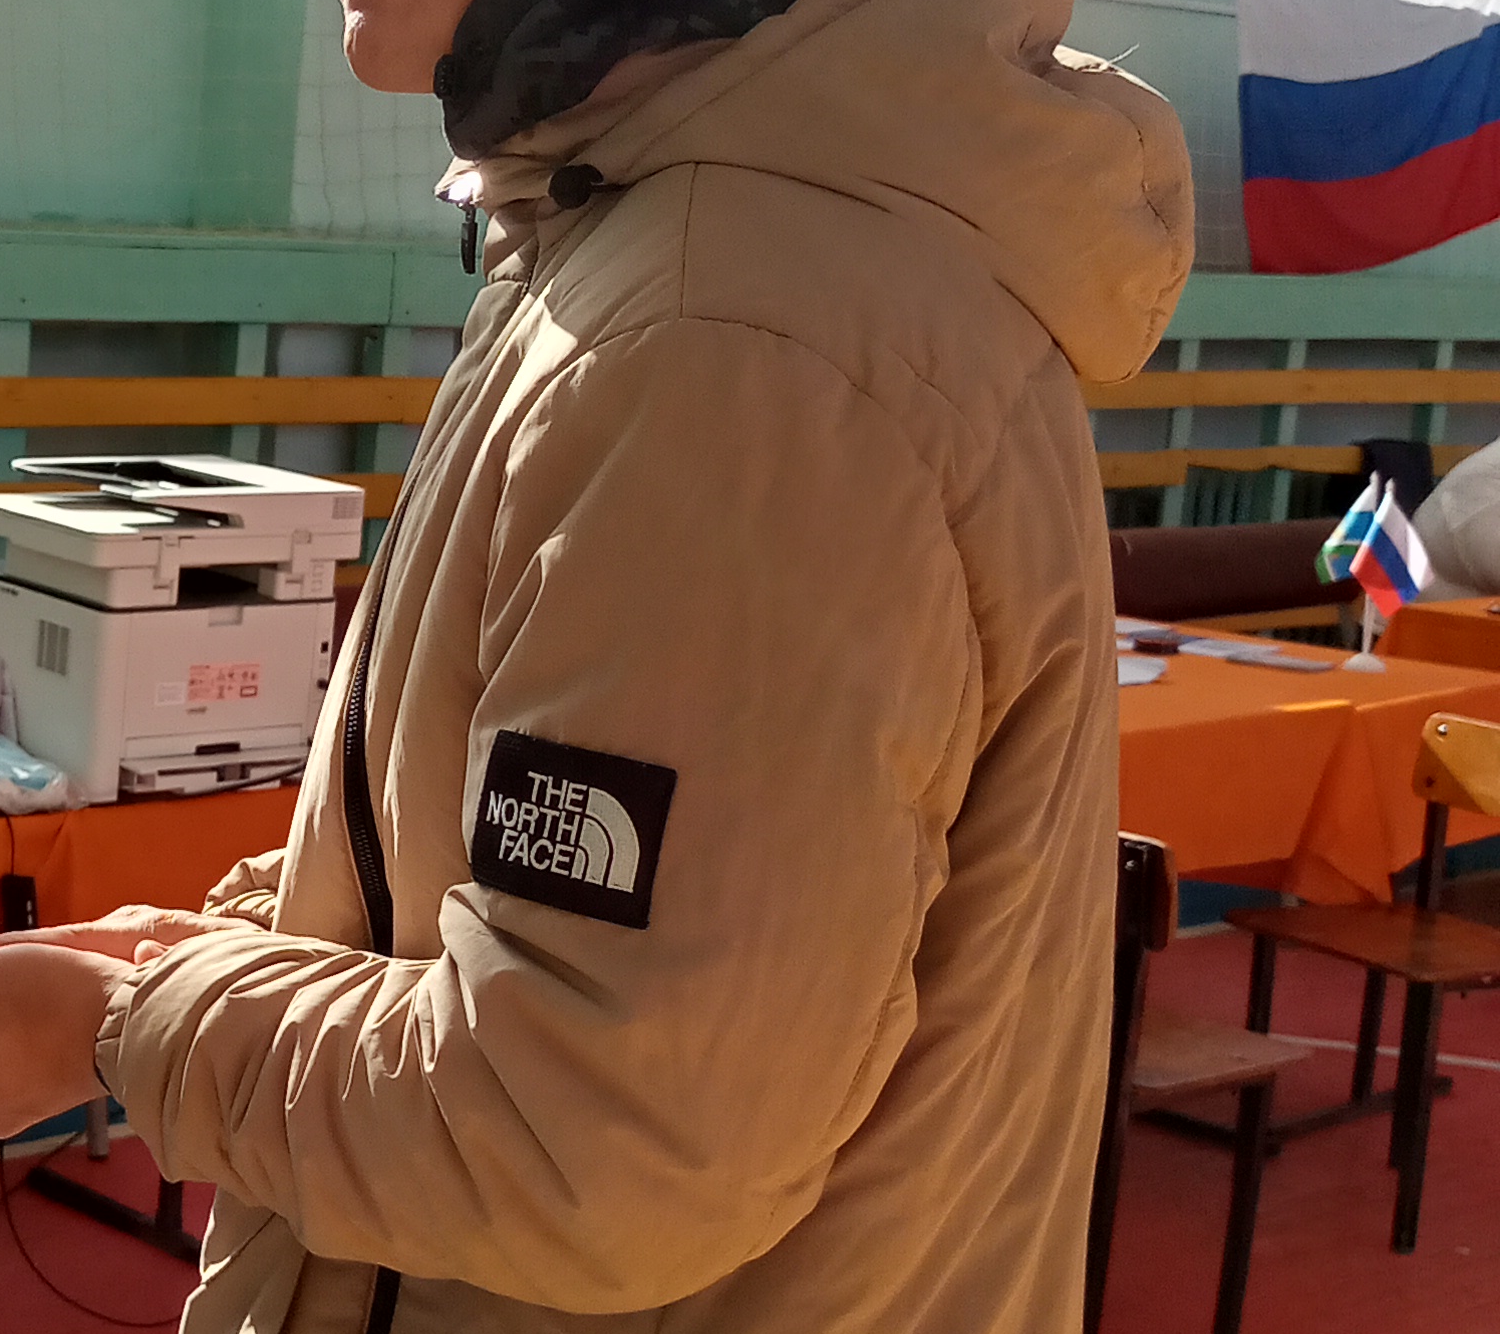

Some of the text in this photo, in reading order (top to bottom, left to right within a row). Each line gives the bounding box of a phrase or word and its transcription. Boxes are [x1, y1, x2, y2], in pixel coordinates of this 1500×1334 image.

[527, 770, 588, 813] THE
[485, 790, 581, 845] NORTH
[498, 828, 575, 876] FACE
